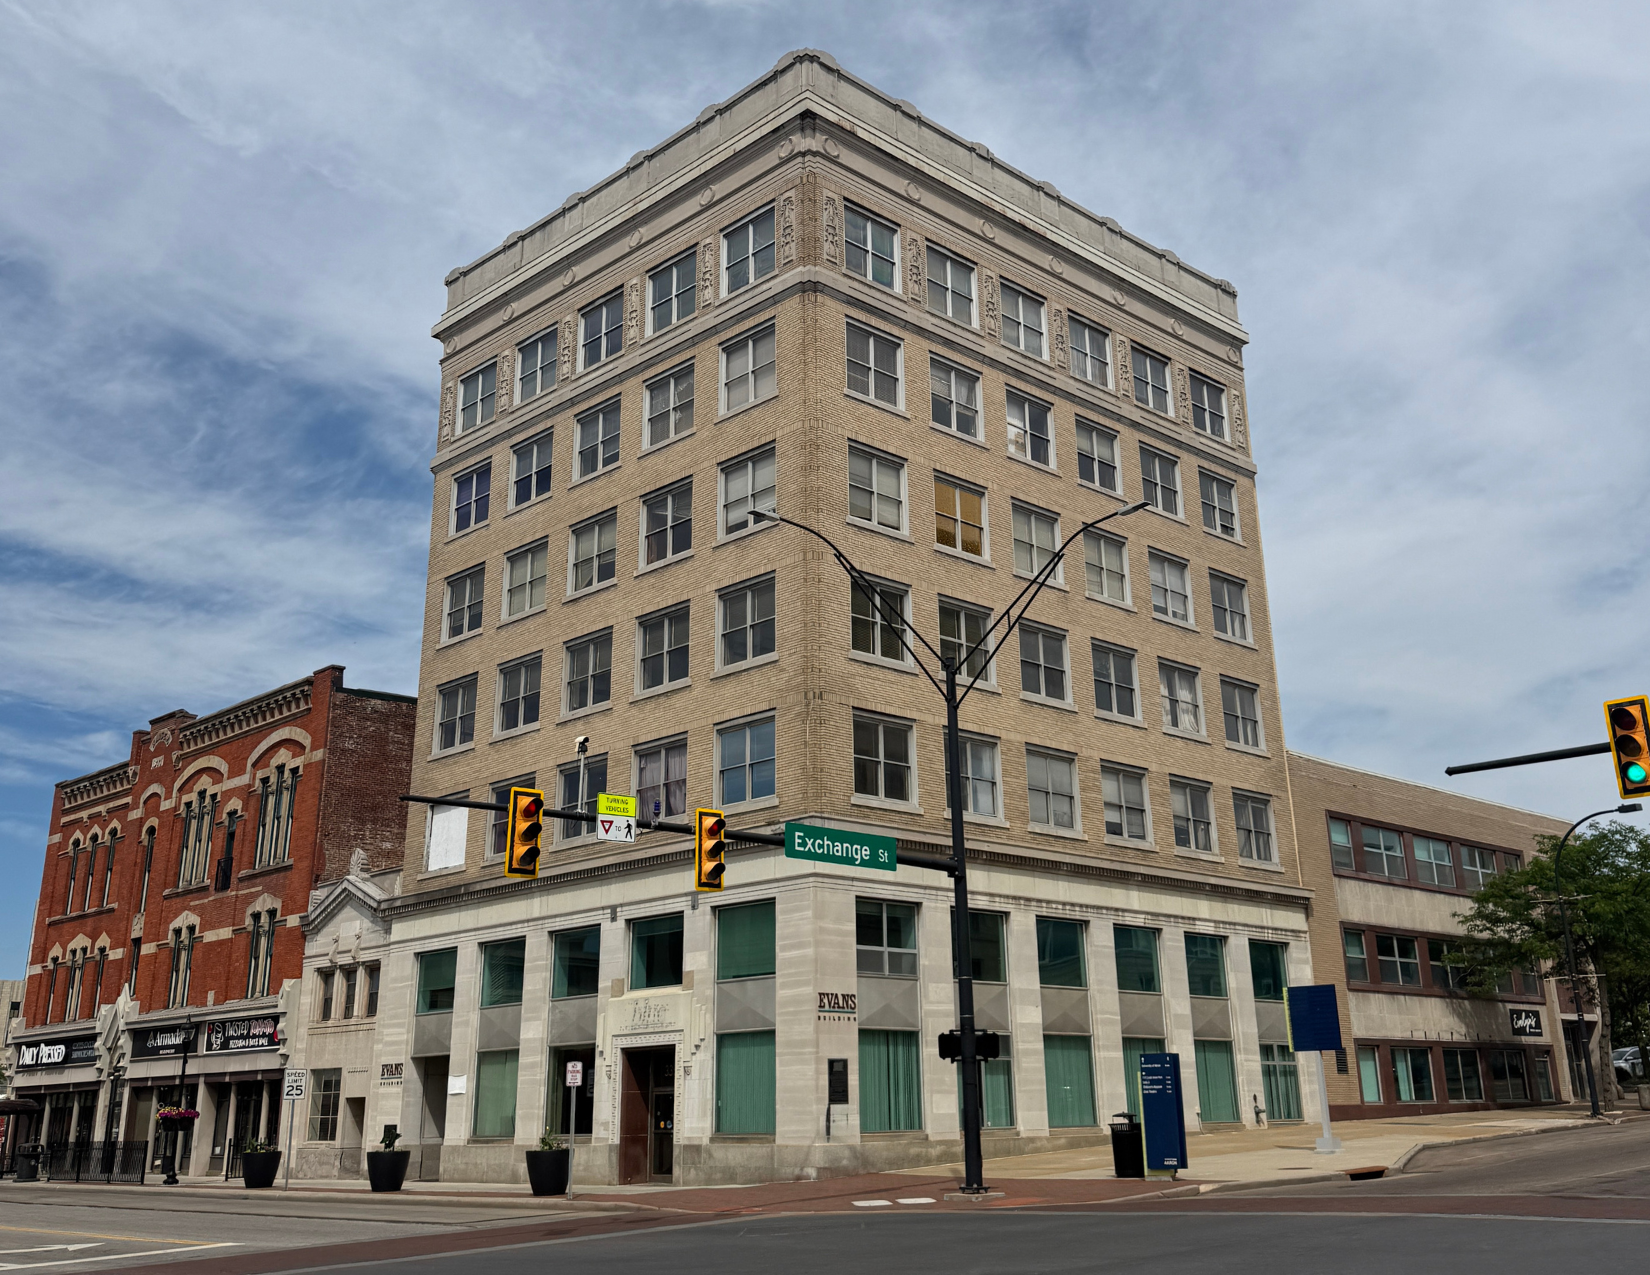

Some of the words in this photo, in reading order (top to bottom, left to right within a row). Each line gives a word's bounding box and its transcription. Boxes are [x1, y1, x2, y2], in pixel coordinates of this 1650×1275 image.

[606, 797, 629, 805] TURNING
[605, 805, 629, 814] VEHICLES
[794, 831, 870, 865] Exchange
[878, 848, 889, 863] St
[818, 992, 857, 1010] EVANS
[225, 1020, 249, 1037] TWISTED
[250, 1018, 275, 1036] TOMATO
[19, 1045, 39, 1065] DAILY
[38, 1043, 66, 1064] PRESSED
[380, 1062, 404, 1077] EVANS
[285, 1084, 303, 1097] 25
